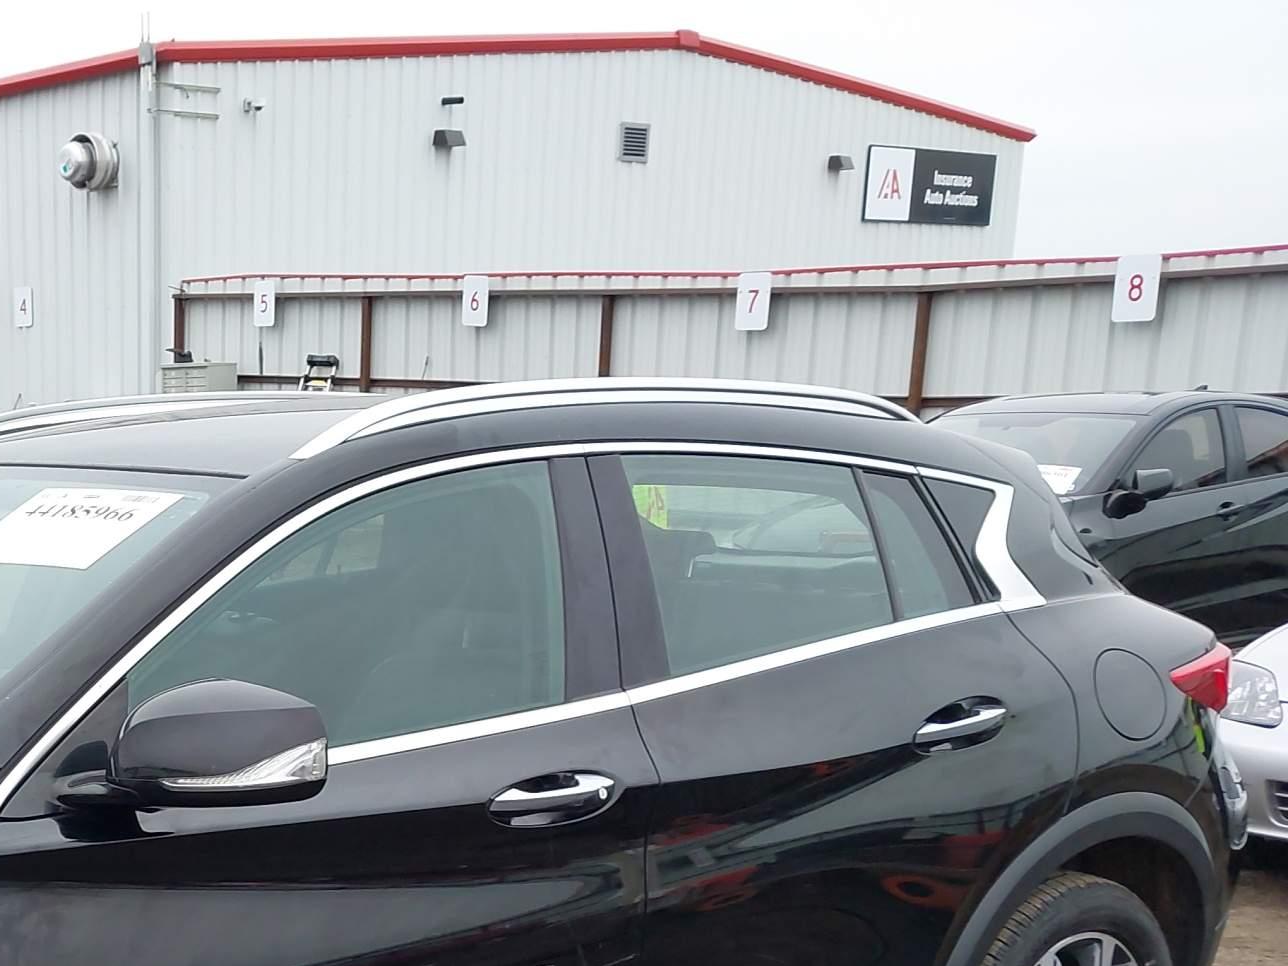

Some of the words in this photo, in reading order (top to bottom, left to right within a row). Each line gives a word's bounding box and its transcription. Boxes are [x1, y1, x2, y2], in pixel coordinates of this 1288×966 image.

[933, 169, 973, 188] Insurance
[923, 188, 944, 205] Auto
[943, 189, 979, 207] Auctions
[1128, 273, 1144, 302] 8
[19, 298, 27, 316] 4
[260, 293, 269, 313] 5
[470, 290, 480, 312] 6
[748, 289, 760, 314] 7
[24, 503, 139, 523] 44185966
